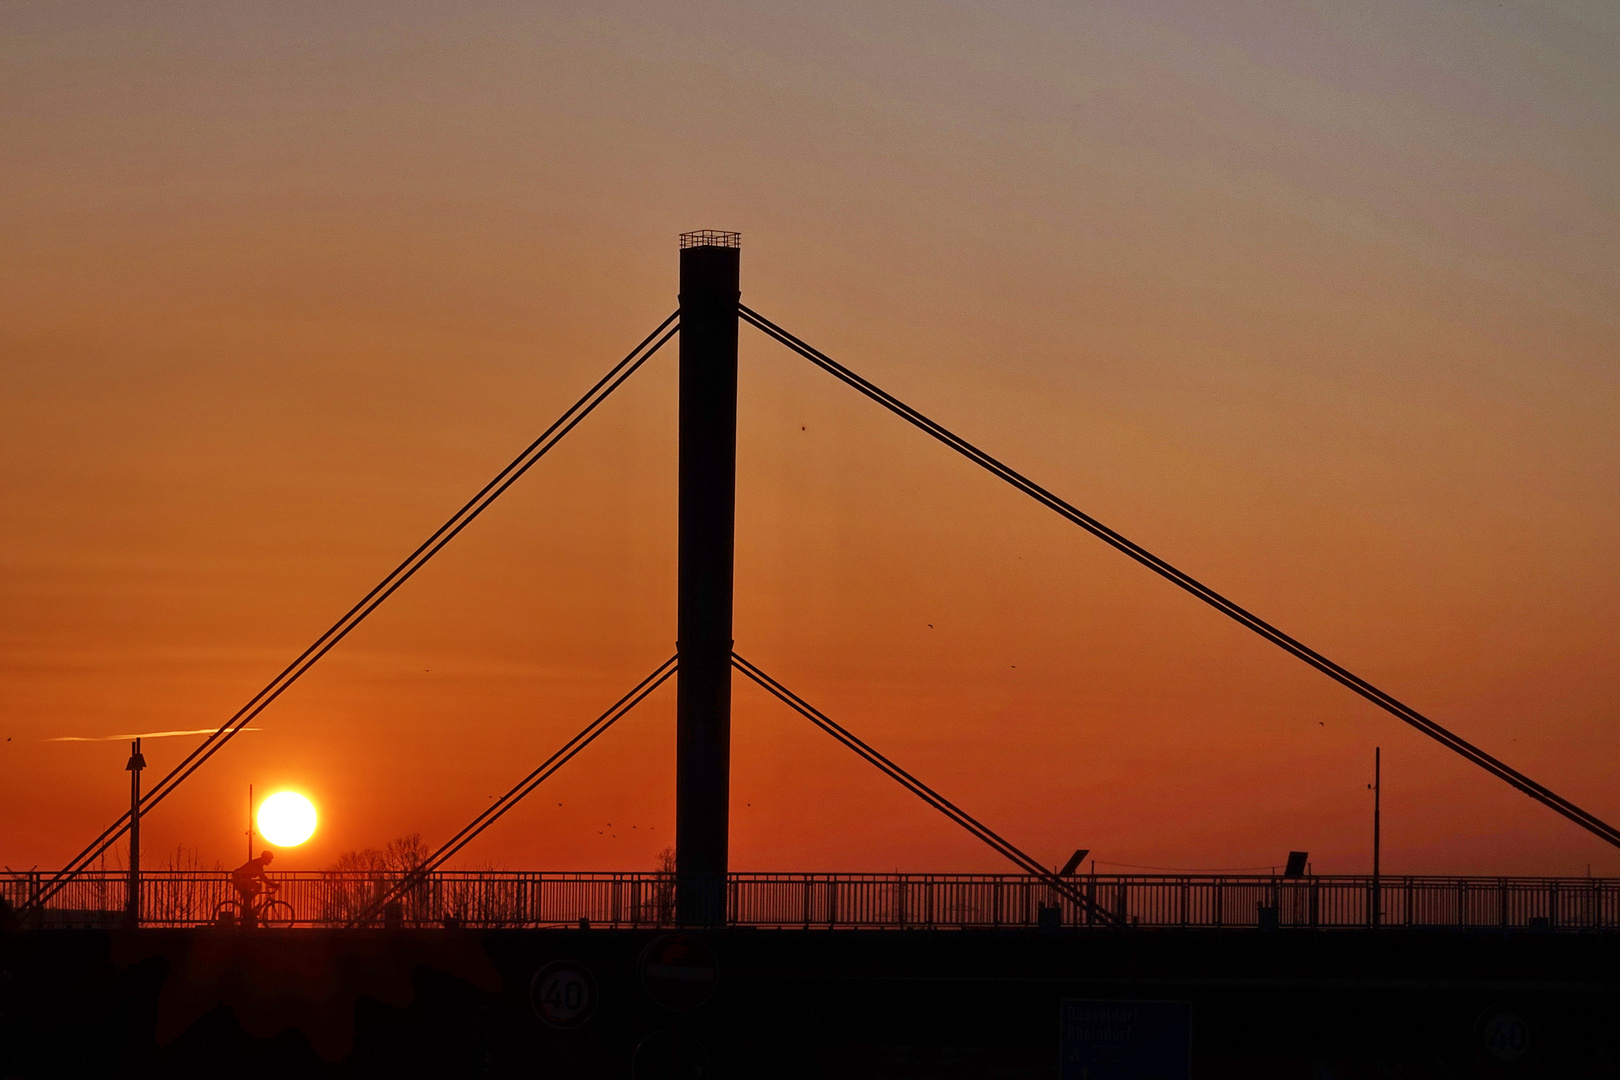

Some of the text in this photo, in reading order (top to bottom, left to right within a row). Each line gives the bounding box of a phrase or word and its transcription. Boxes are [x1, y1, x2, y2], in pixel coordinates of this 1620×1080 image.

[544, 978, 582, 1010] 40
[1067, 1006, 1138, 1023] Düsseldorf
[1067, 1025, 1132, 1041] Rheindorf
[1488, 1021, 1526, 1051] 40
